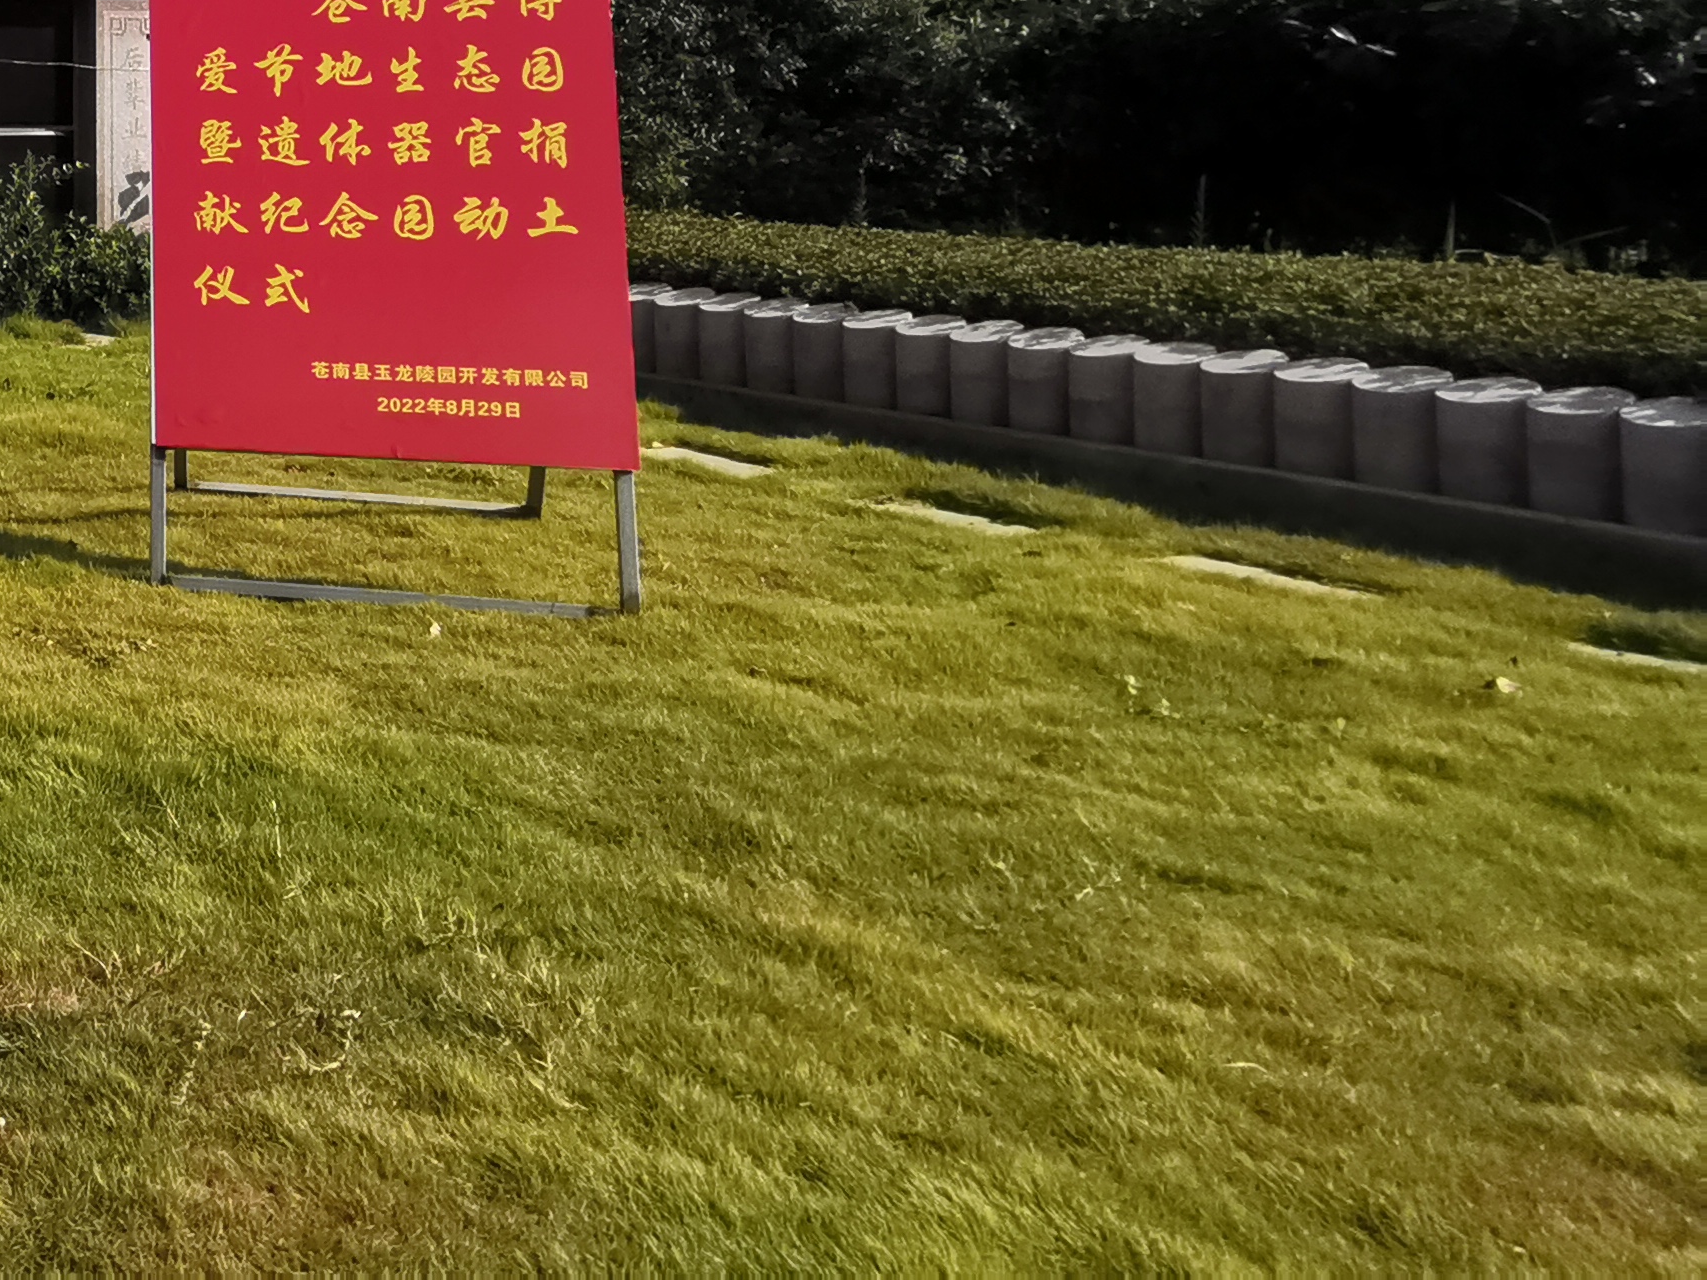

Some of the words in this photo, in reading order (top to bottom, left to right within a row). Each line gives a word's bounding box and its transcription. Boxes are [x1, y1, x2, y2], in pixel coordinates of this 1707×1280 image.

[195, 43, 564, 97] 爱节地生态园
[198, 115, 568, 169] 暨遗体器官捐
[193, 191, 580, 241] 献纪念园动土
[193, 263, 310, 314] 仪式
[312, 360, 589, 391] 苍南县玉龙陵园开发有限公司
[377, 396, 521, 419] 2022年8月29日
